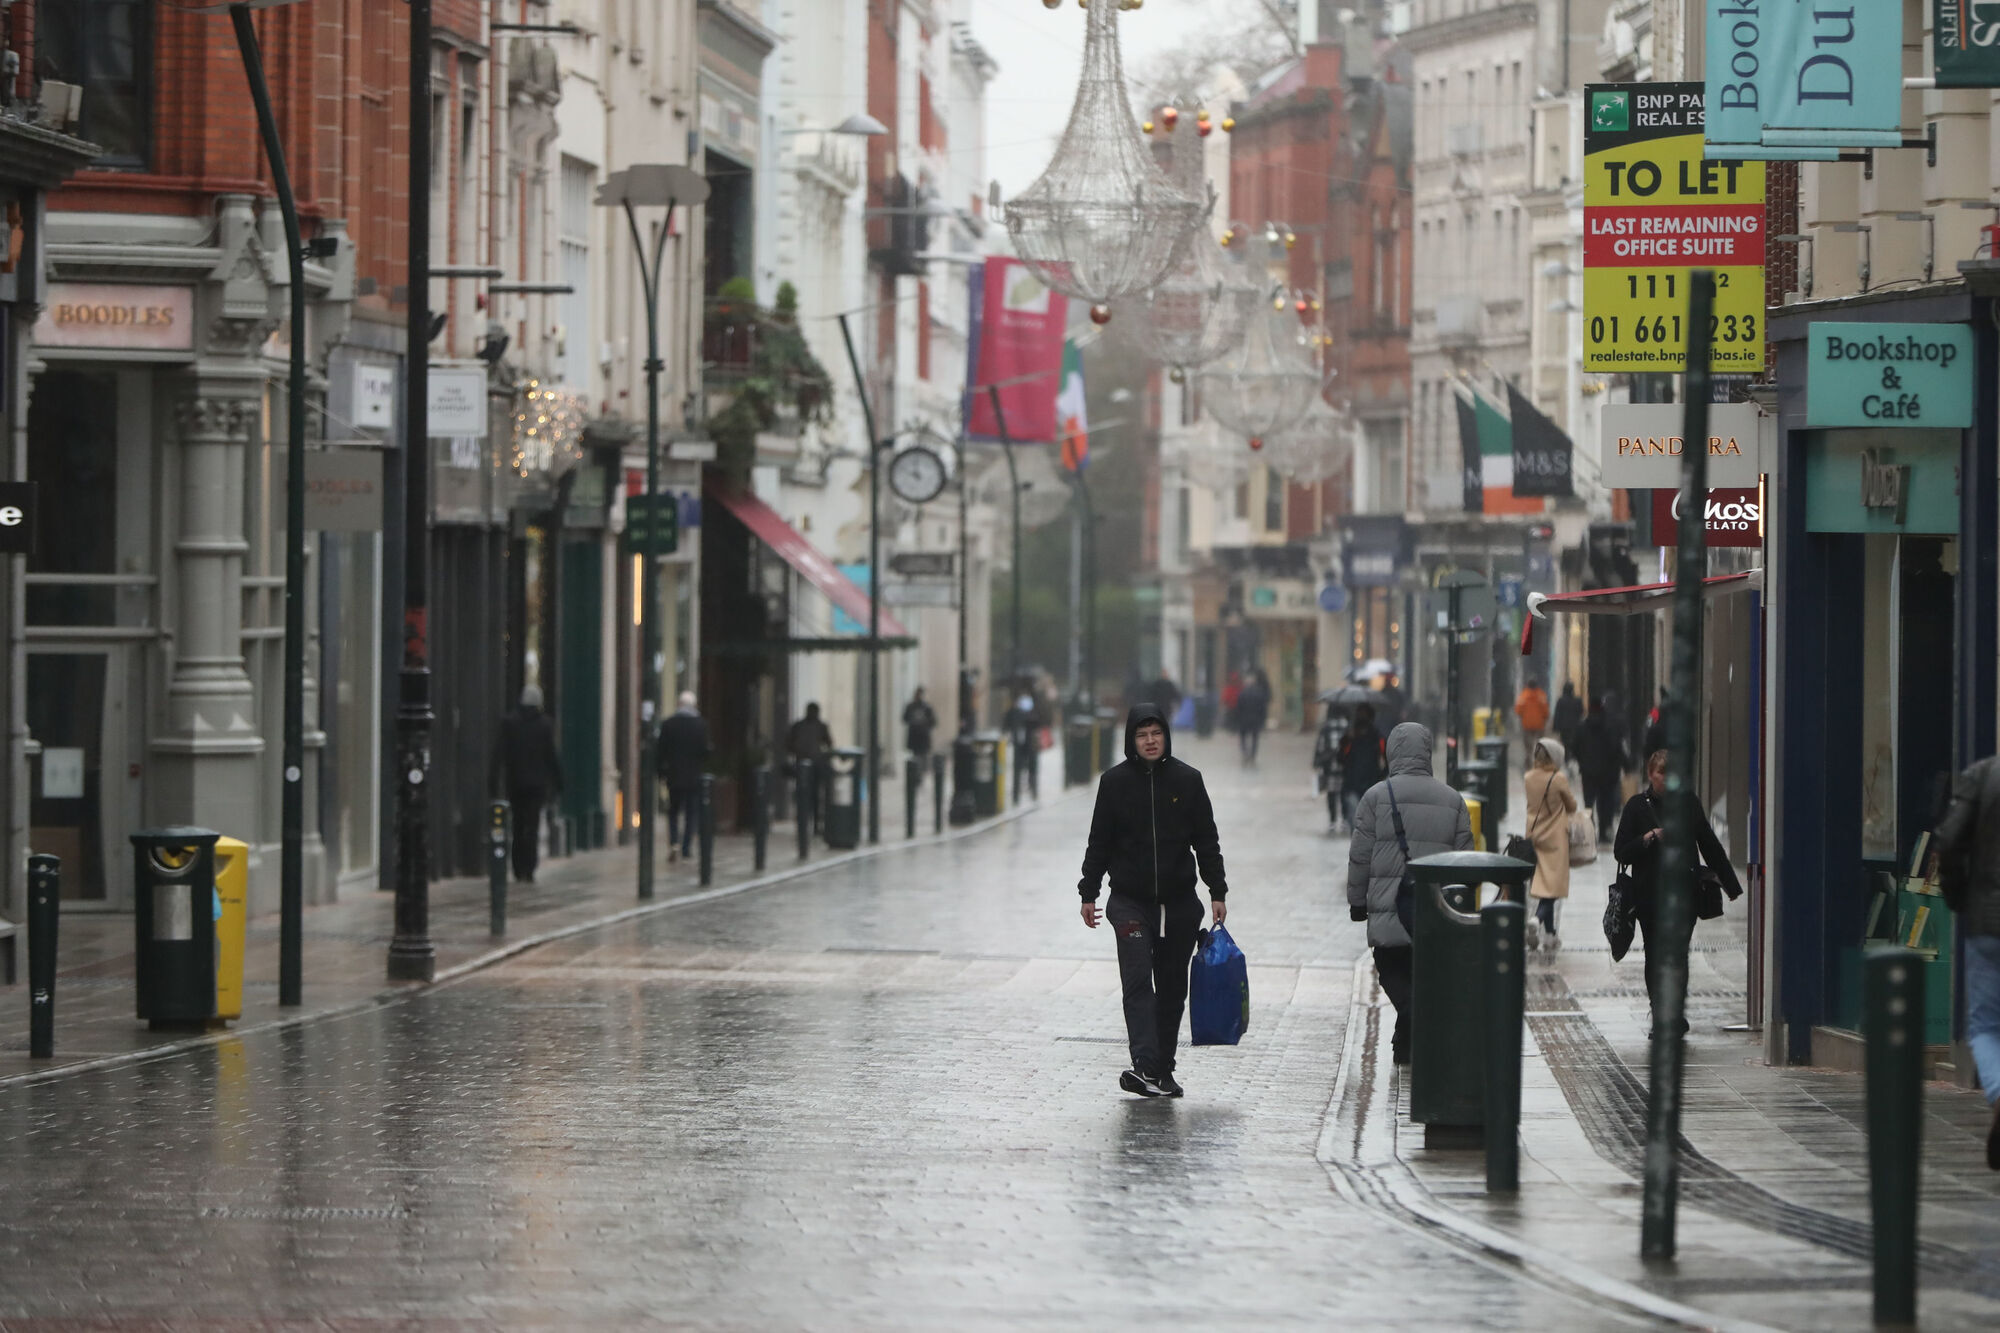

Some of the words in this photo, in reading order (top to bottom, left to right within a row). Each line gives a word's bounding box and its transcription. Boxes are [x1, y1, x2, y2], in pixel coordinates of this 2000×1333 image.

[1941, 0, 1959, 47] IFTS
[1718, 0, 1759, 112] Book
[1797, 0, 1855, 106] Du
[1637, 95, 1674, 109] BNP
[1679, 94, 1705, 109] PA
[1637, 112, 1682, 126] REAL
[1686, 111, 1705, 126] ES
[1604, 160, 1662, 197] TO
[1679, 160, 1743, 195] LET
[1591, 218, 1636, 235] LAST
[1641, 215, 1758, 234] REMAINING
[1613, 239, 1677, 256] OFFICE
[1682, 238, 1734, 255] SUITE
[1628, 275, 1675, 298] 111
[56, 304, 174, 327] BOODLES
[1591, 316, 1618, 343] 01
[1635, 316, 1680, 343] 661
[1709, 314, 1756, 343] 233
[1590, 348, 1756, 365] realestate.bnpibas.ie
[1826, 335, 1957, 367] Bookshop
[1881, 366, 1902, 389] &
[1862, 393, 1920, 419] Café
[1618, 436, 1742, 456] PANDRA
[1515, 450, 1569, 476] M&S
[1671, 489, 1759, 521] no's
[1705, 521, 1749, 530] ELATO
